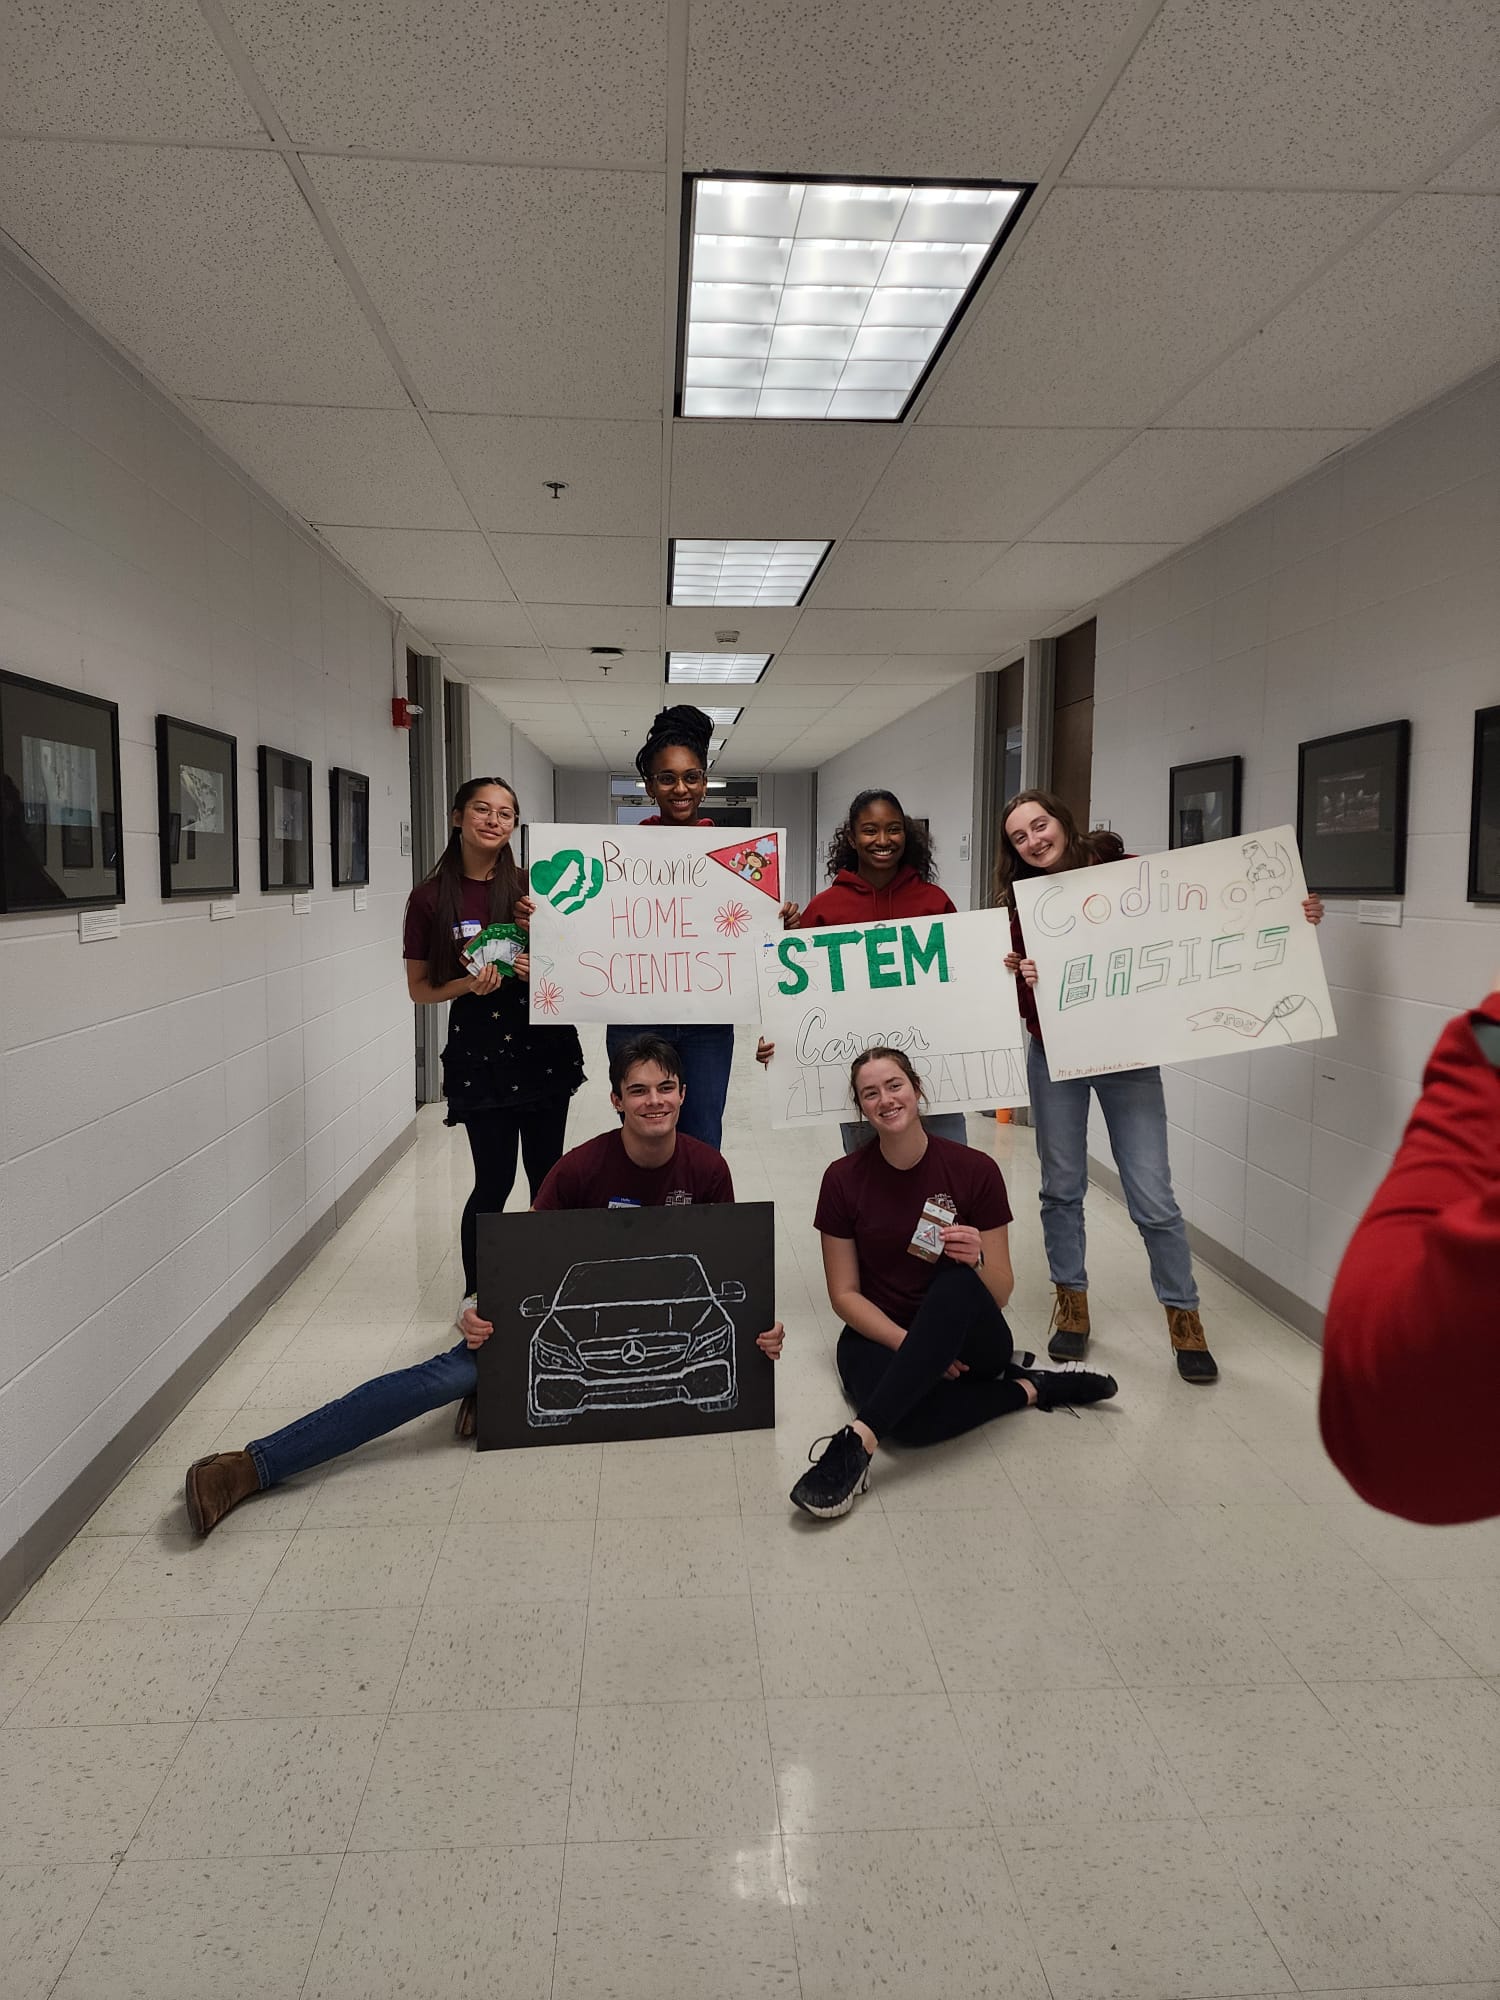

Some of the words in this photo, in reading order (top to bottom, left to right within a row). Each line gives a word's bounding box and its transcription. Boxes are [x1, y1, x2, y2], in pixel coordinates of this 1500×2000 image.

[602, 840, 709, 888] Brownie
[610, 896, 699, 939] HOME
[1033, 860, 1256, 938] Coding
[577, 950, 737, 998] SCIENTIST
[777, 921, 950, 996] STEM
[1059, 925, 1290, 1012] BASICS
[795, 1006, 930, 1066] Career
